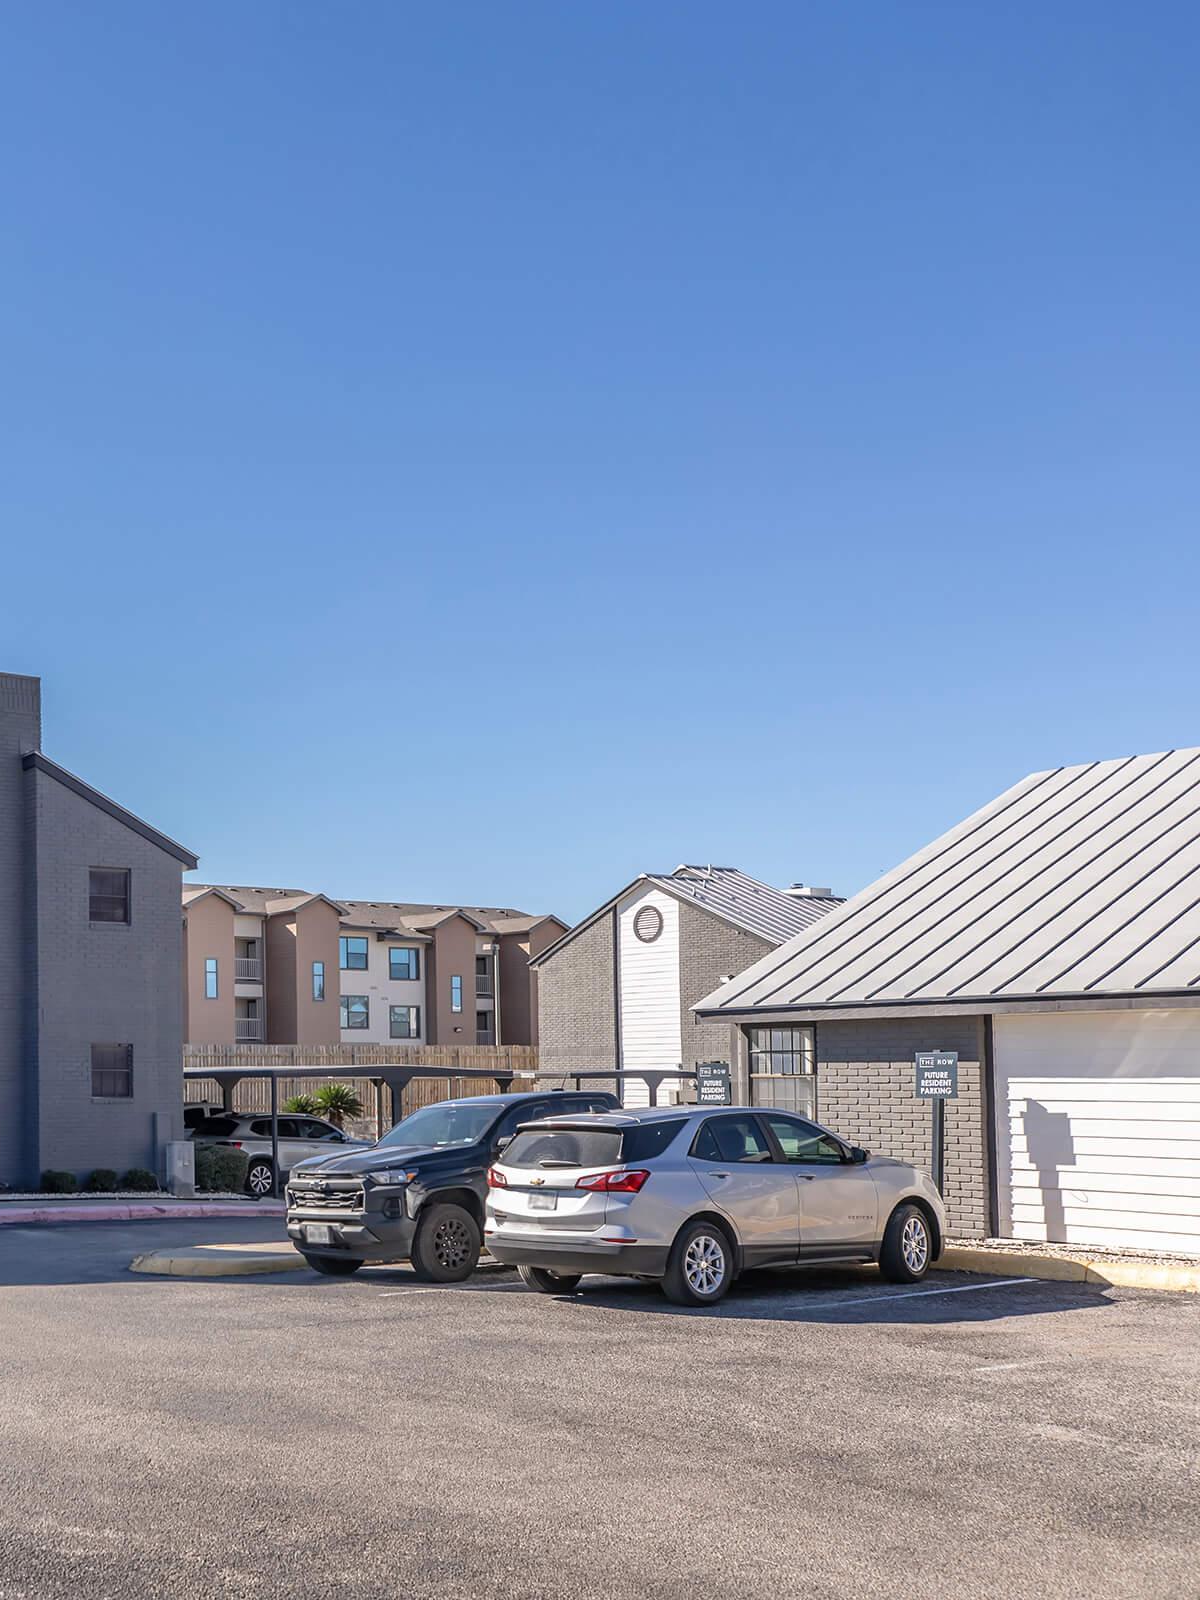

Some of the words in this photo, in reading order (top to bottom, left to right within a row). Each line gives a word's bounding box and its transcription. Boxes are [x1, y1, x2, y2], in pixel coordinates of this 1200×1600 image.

[920, 1058, 934, 1067] THE
[924, 1071, 949, 1079] FUTURE
[920, 1079, 952, 1087] RESIDENT
[920, 1087, 952, 1095] PARKING
